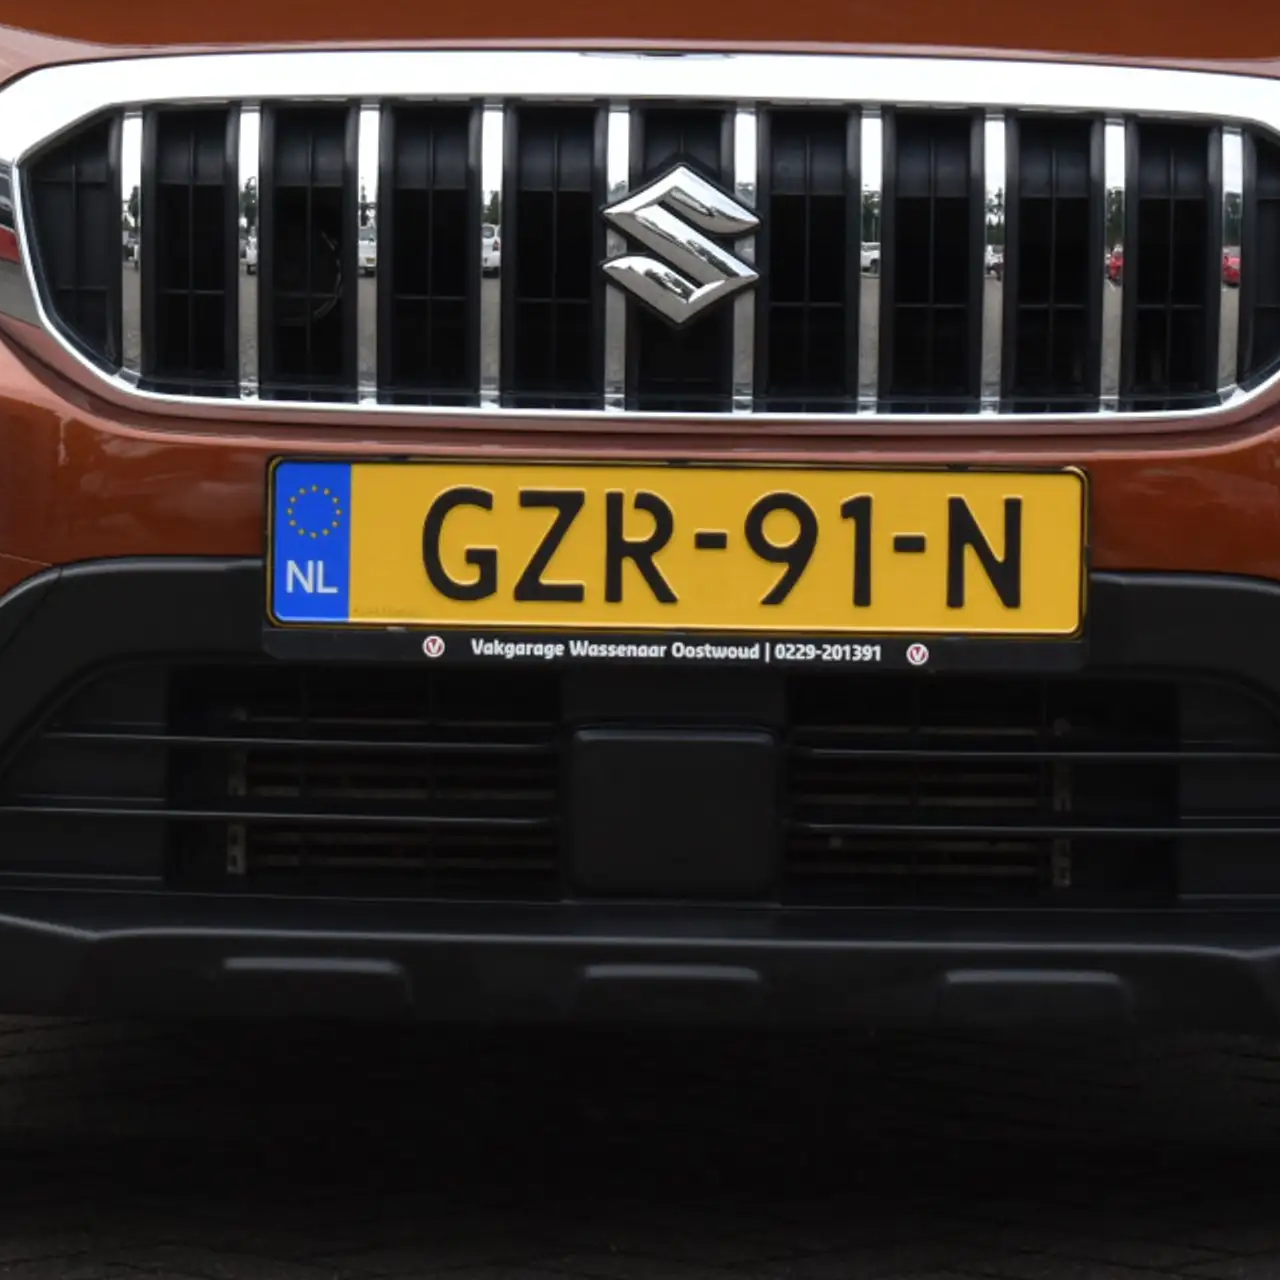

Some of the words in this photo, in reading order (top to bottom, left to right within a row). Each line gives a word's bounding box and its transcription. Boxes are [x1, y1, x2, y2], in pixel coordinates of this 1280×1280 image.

[421, 485, 1023, 609] GZR-91-N
[285, 560, 339, 595] NL
[471, 638, 564, 659] Vakgarage
[570, 640, 666, 657] Wassenaar
[671, 641, 759, 659] Oostwoud
[775, 643, 881, 661] 0229-201391
